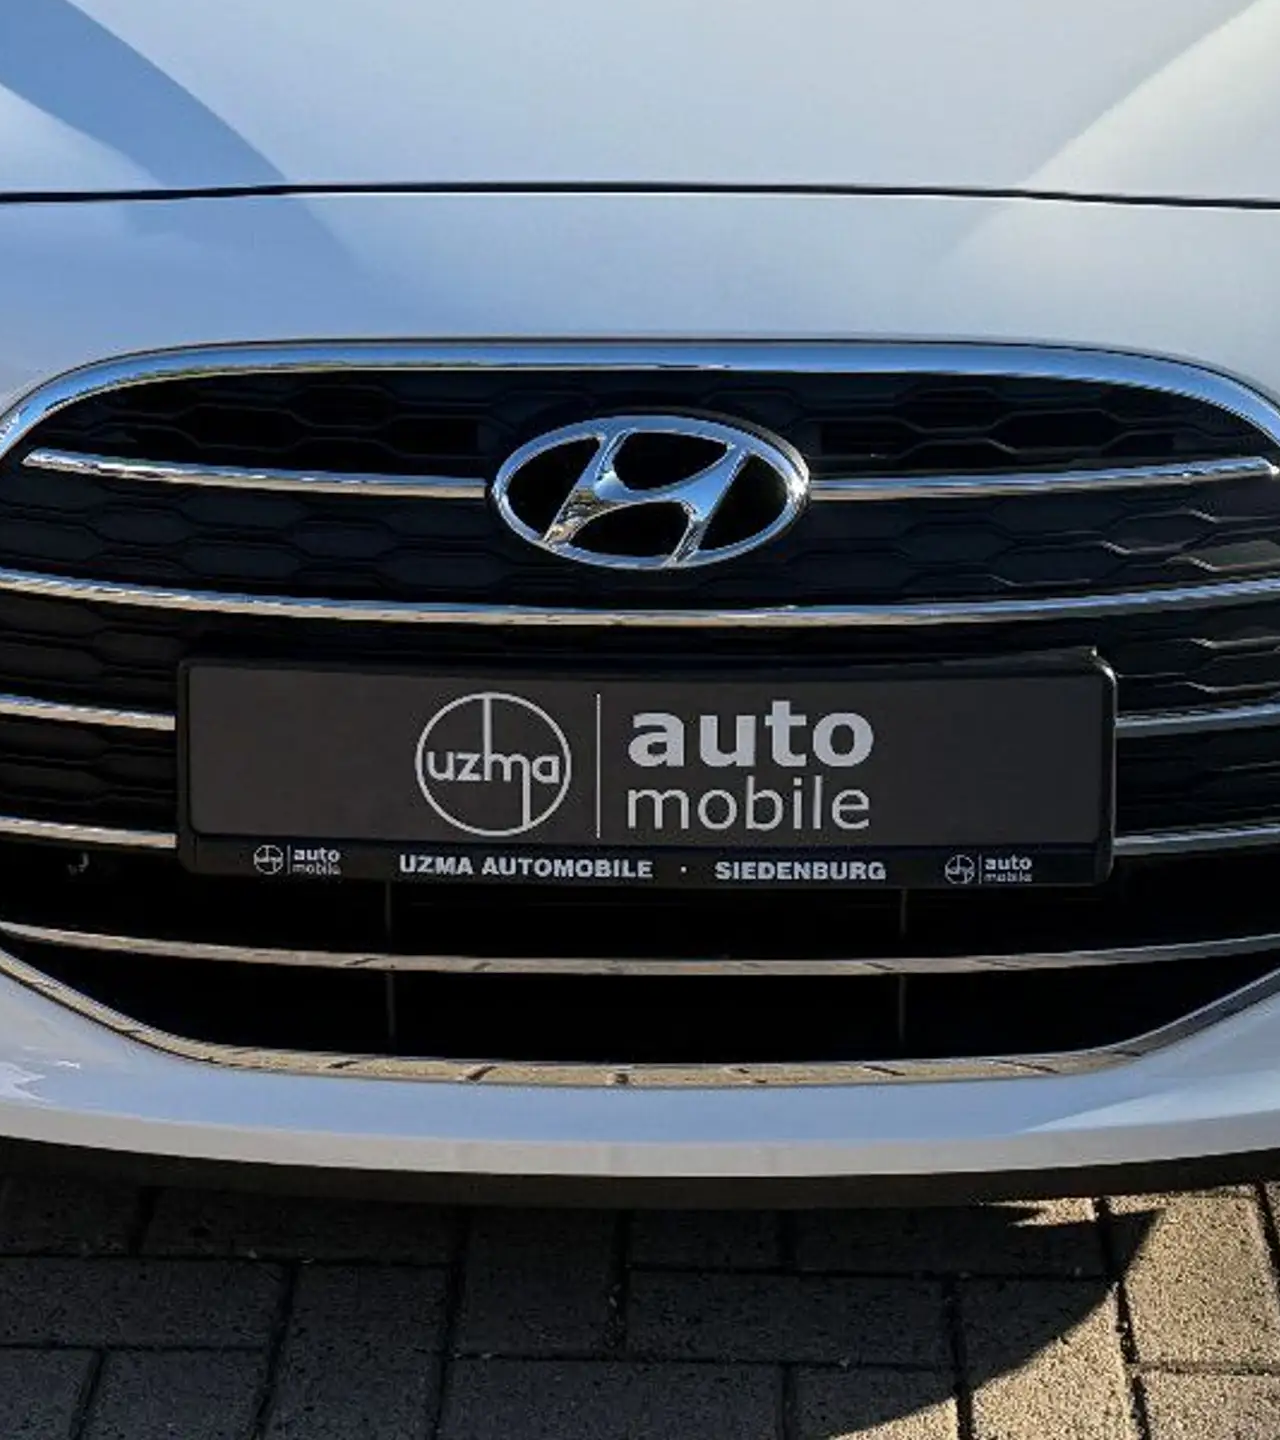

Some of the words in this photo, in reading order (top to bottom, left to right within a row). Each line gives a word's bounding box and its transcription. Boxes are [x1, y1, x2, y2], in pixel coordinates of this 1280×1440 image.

[627, 700, 875, 768] auto
[627, 775, 870, 832] mobile
[293, 847, 341, 863] auto
[399, 854, 475, 876] UZMA
[480, 856, 654, 878] AUTOMOBILE
[714, 861, 887, 880] SIEDENBURG
[984, 855, 1033, 871] auto
